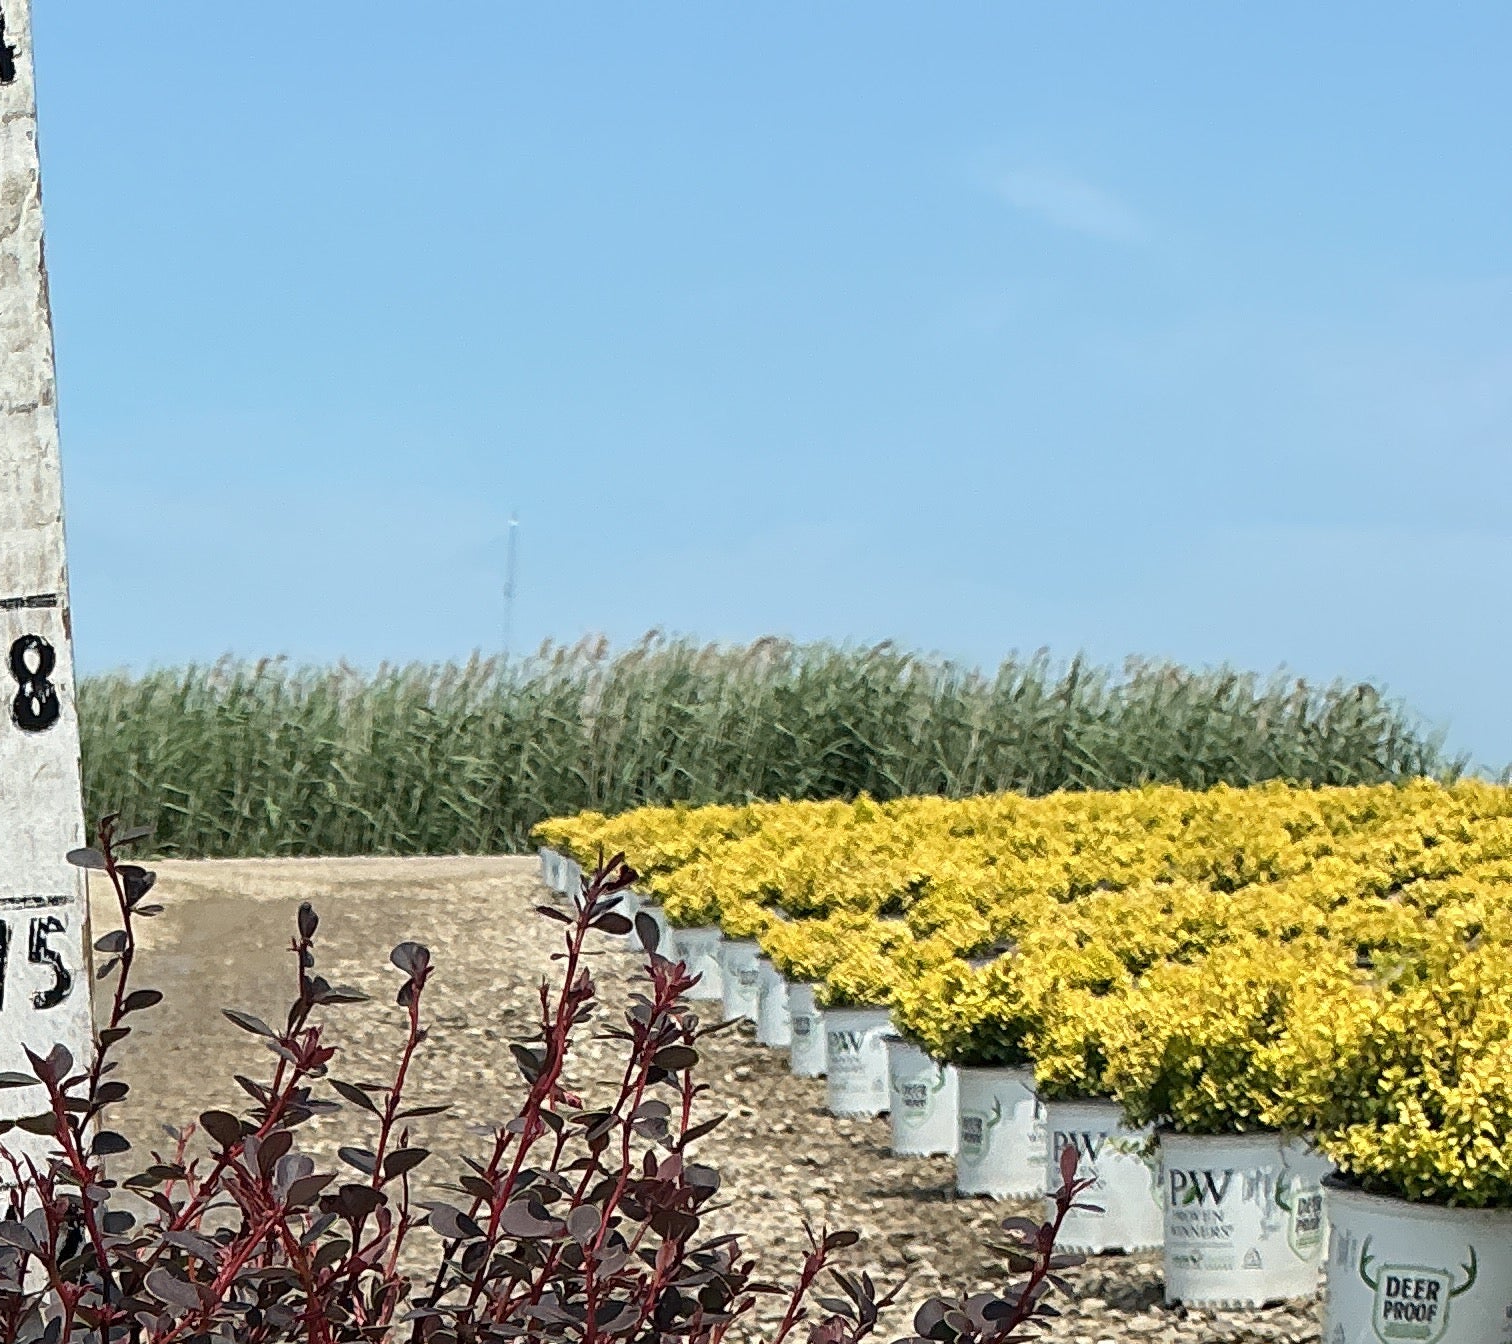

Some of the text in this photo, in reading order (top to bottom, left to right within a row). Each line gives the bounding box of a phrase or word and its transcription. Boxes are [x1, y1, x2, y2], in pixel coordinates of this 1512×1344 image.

[1169, 1167, 1235, 1207] PW
[1385, 1275, 1441, 1302] DEER
[1383, 1300, 1439, 1323] PROOF
